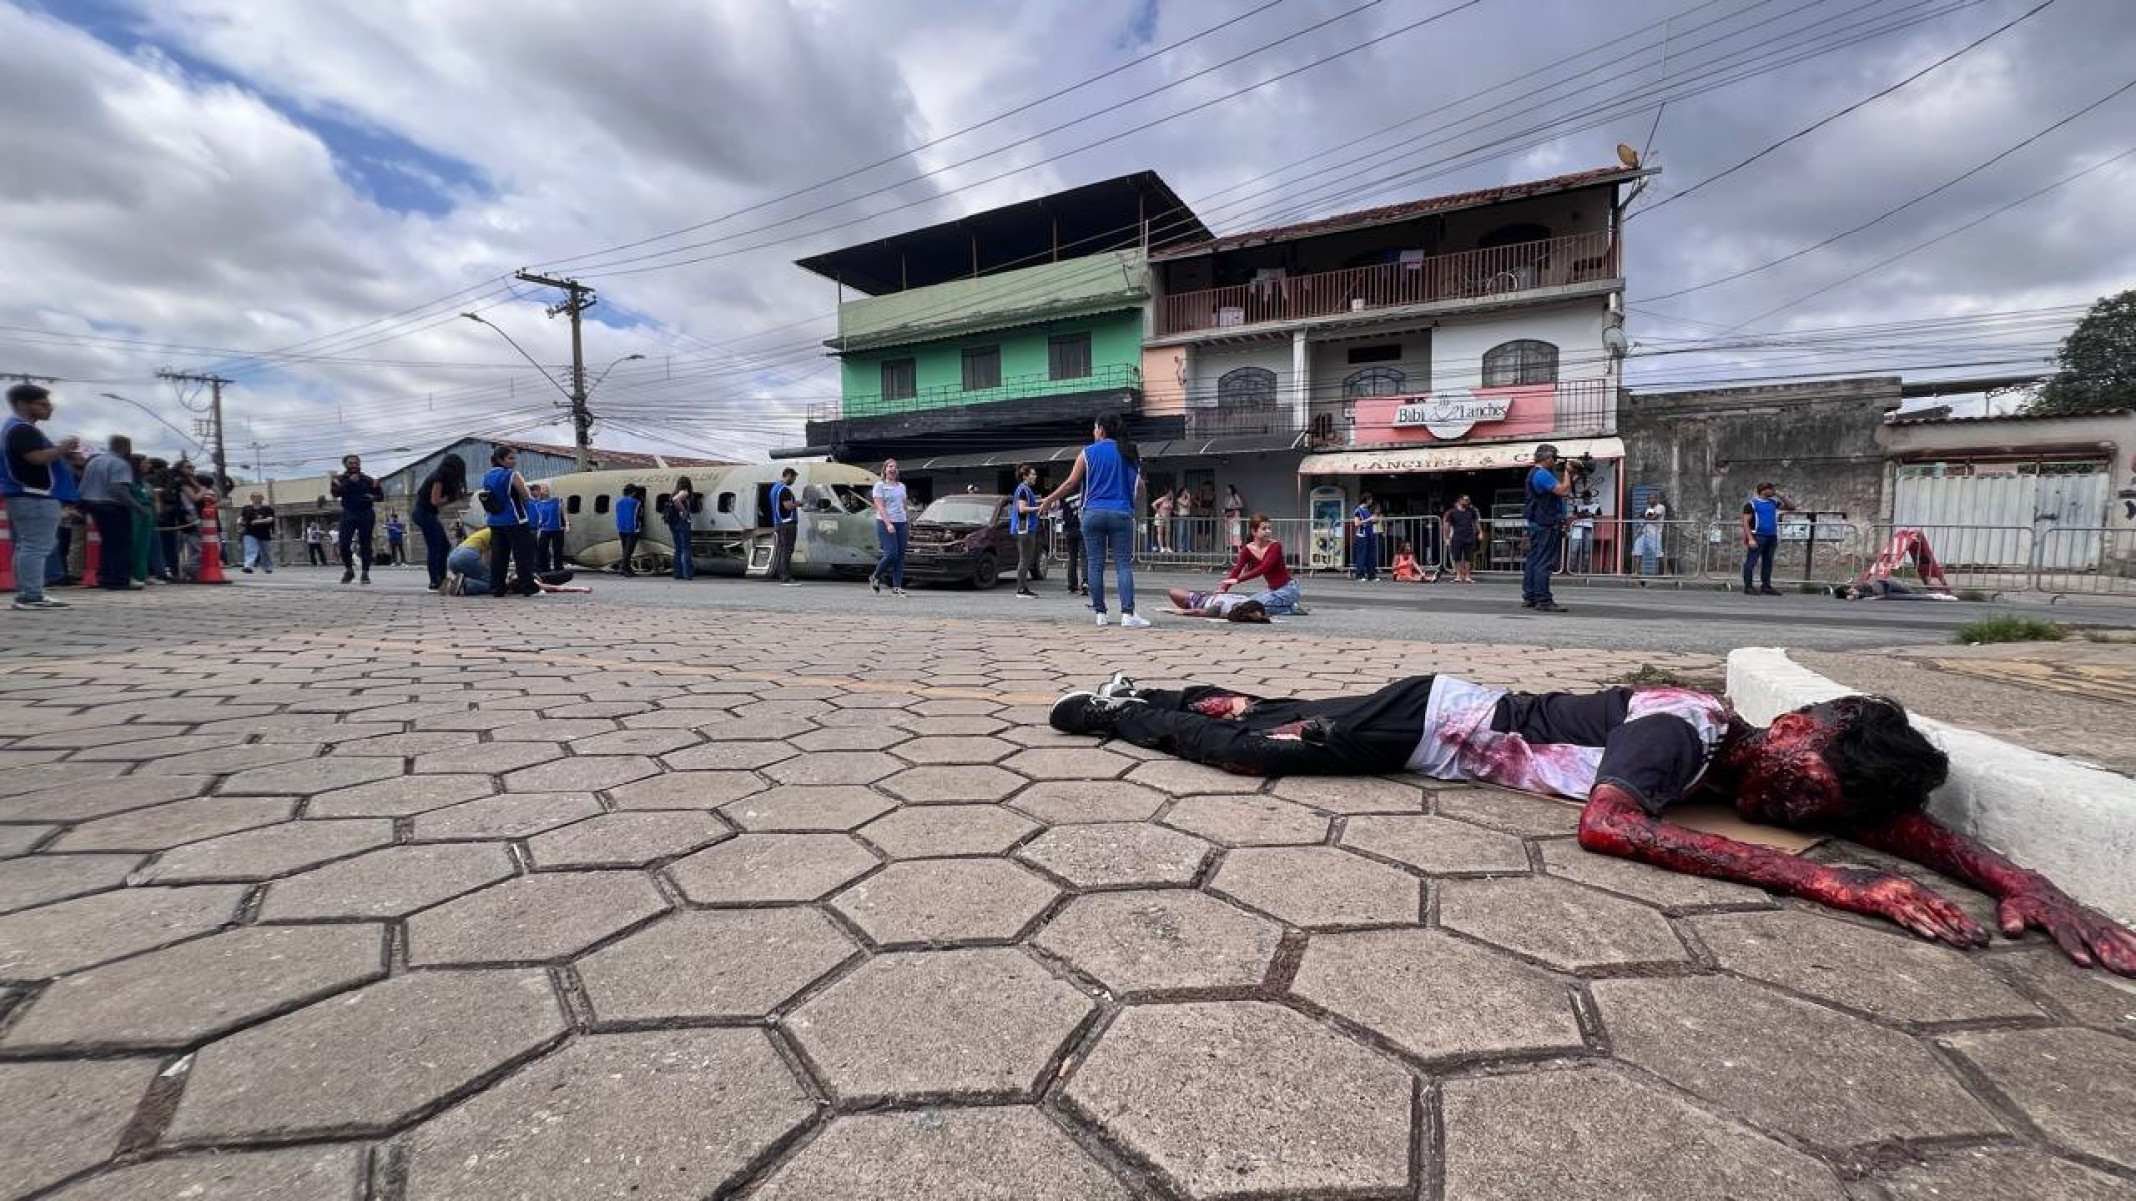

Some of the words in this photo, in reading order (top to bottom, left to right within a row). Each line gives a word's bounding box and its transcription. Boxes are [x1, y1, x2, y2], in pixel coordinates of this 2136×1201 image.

[1399, 408, 1424, 422] Bibi
[1460, 403, 1506, 417] Lanches
[1353, 458, 1463, 471] LANCHES
